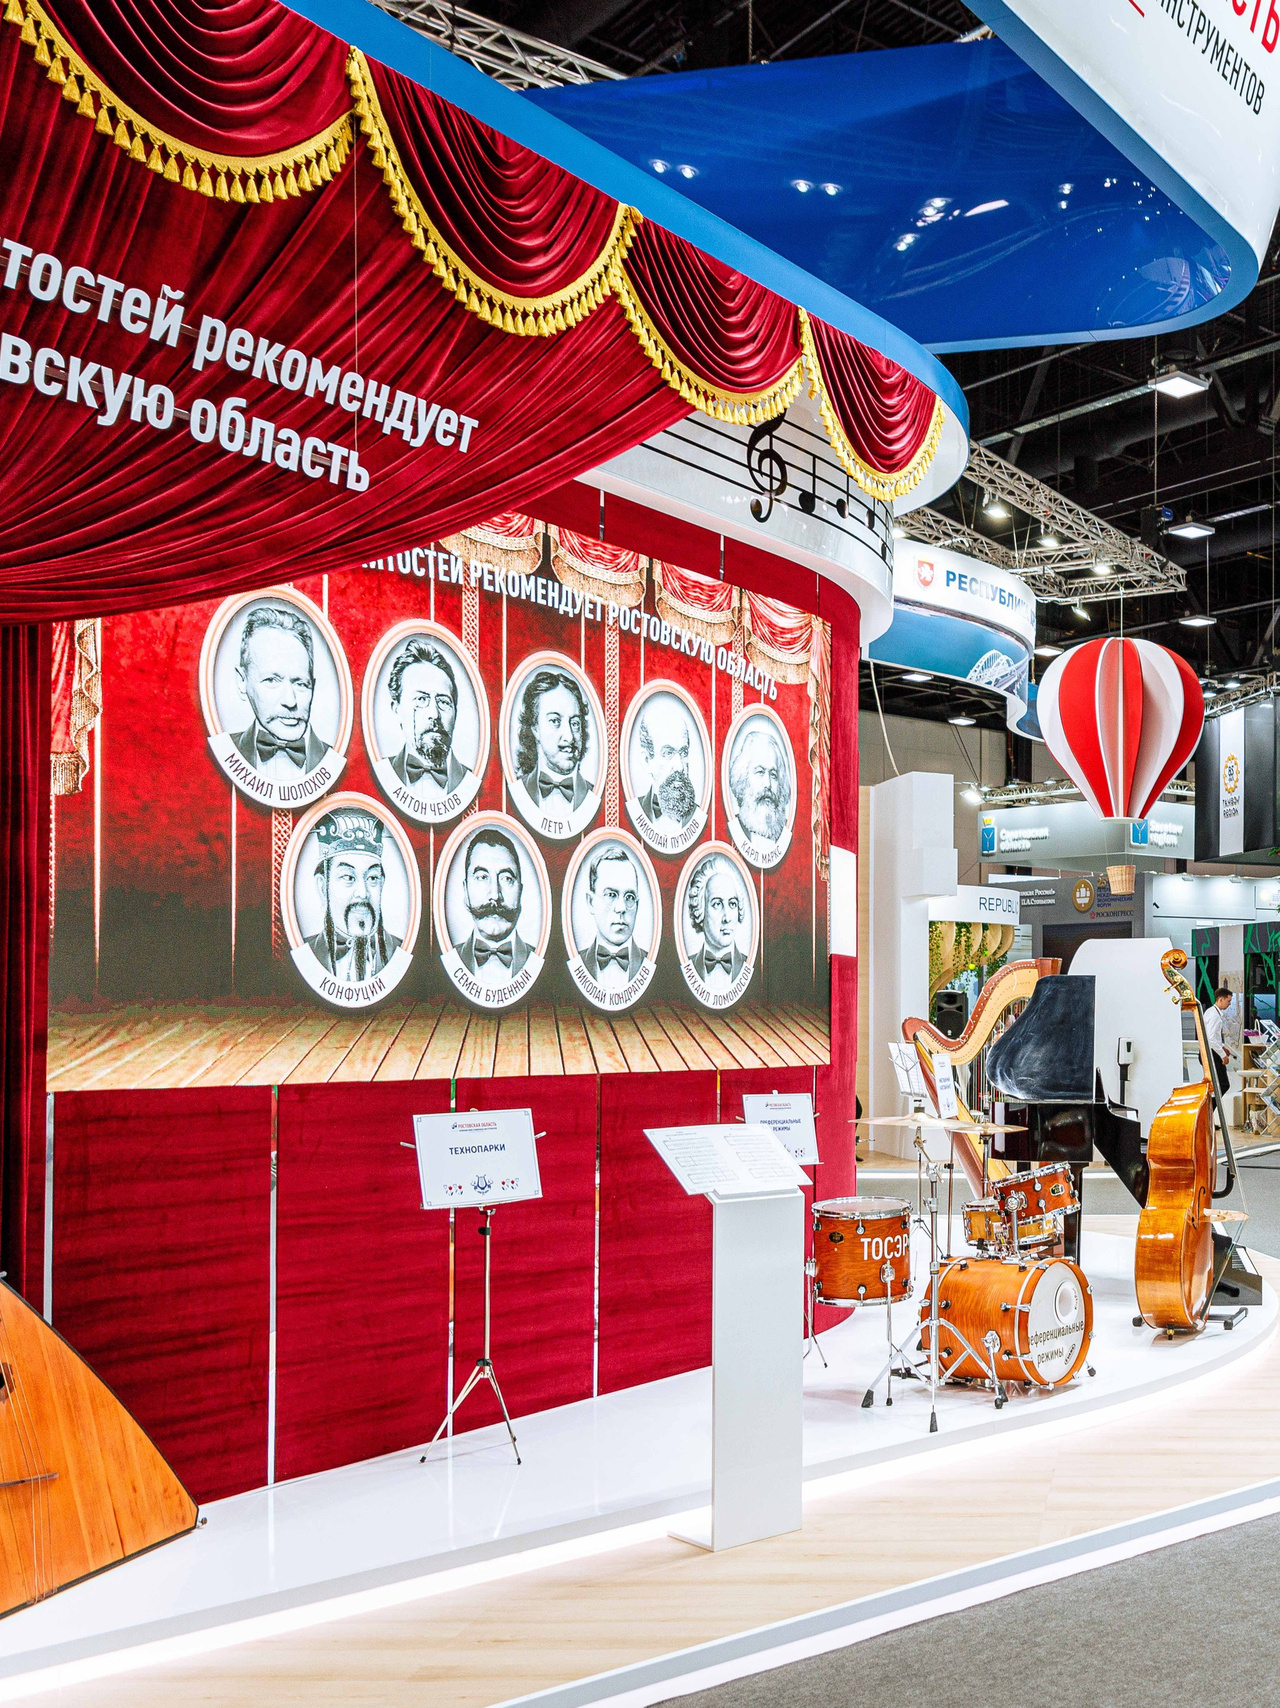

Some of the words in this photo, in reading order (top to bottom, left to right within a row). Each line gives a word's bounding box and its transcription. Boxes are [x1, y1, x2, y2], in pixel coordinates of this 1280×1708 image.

[3, 238, 185, 347] тостей
[192, 314, 479, 453] рекомендует
[0, 332, 174, 430] вскую
[190, 397, 370, 492] область
[470, 559, 604, 622] РЕКОМЕНДУЕТ
[608, 601, 716, 665] РОСТОВСКУЮ
[716, 646, 778, 701] ОБЛАСТЬ
[224, 752, 273, 798] МИХАИЛ
[278, 767, 332, 801] ШОЛОХОВ
[392, 786, 427, 816] АНТОН
[430, 793, 462, 816] ЧЕХОВ
[541, 817, 565, 834] ПЕТР
[635, 813, 669, 848] НИКОЛАЙ
[670, 817, 700, 849] ПУТИЛОВ
[741, 840, 759, 862] КАРЛ
[761, 846, 783, 864] МАРКС
[319, 976, 386, 1001] КОНФУЦИЙ
[453, 967, 481, 998] СЕМЕН
[485, 968, 532, 1004] БУДЕННЫЙ
[574, 964, 607, 1003] НИКОЛАЙ
[609, 965, 650, 1006] КОНДРАТЬЕВ
[684, 963, 710, 1003] МИХАИЛ
[713, 966, 752, 1006] ЛОМОНОСОВ
[449, 1143, 506, 1155] ТЕХНОПАРКИ
[860, 1234, 909, 1261] ТОСЭР
[1037, 1347, 1065, 1368] режимы
